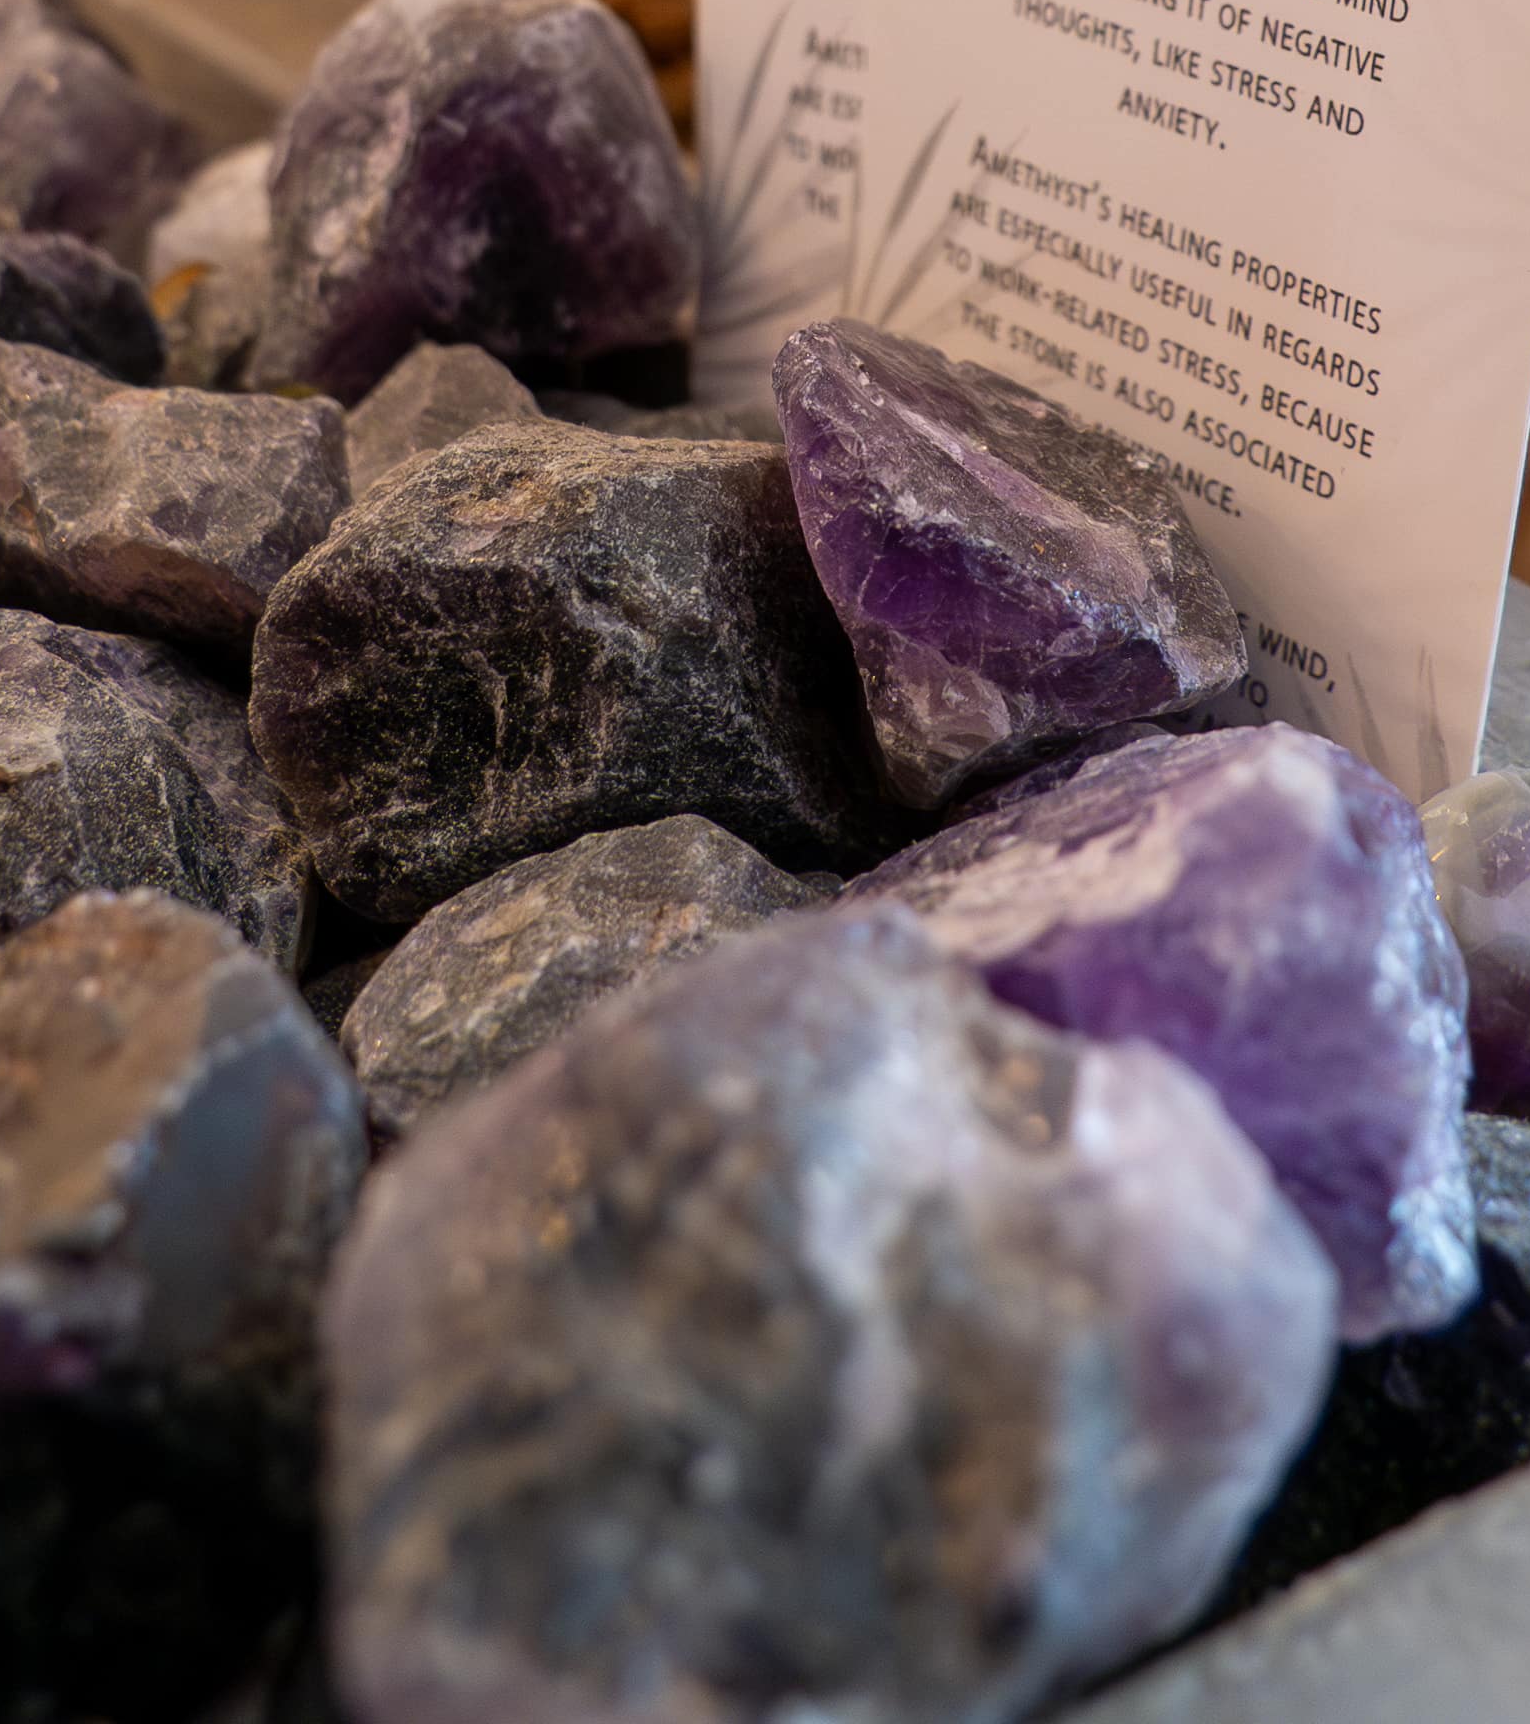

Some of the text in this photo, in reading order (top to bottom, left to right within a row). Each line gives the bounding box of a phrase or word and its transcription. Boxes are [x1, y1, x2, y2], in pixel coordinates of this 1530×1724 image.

[1151, 38, 1202, 78] LIKE
[1209, 59, 1297, 113] STRESS
[1306, 94, 1365, 137] AND
[1218, 3, 1252, 35] OF
[1260, 15, 1386, 83] NEGATIVE
[1117, 87, 1227, 151] ANXIETY.
[950, 190, 1381, 398] ARE ESPECIALLY USEFUL IN REGARDS
[969, 135, 1382, 335] AMETHYST'S HEALING PROPERTIES
[941, 237, 1376, 460] TO WORK-RELATED STRESS, BECAUSE
[959, 300, 1336, 500] THE STONE IS ALSO ASSOCIATED
[1258, 622, 1336, 694] WIND,
